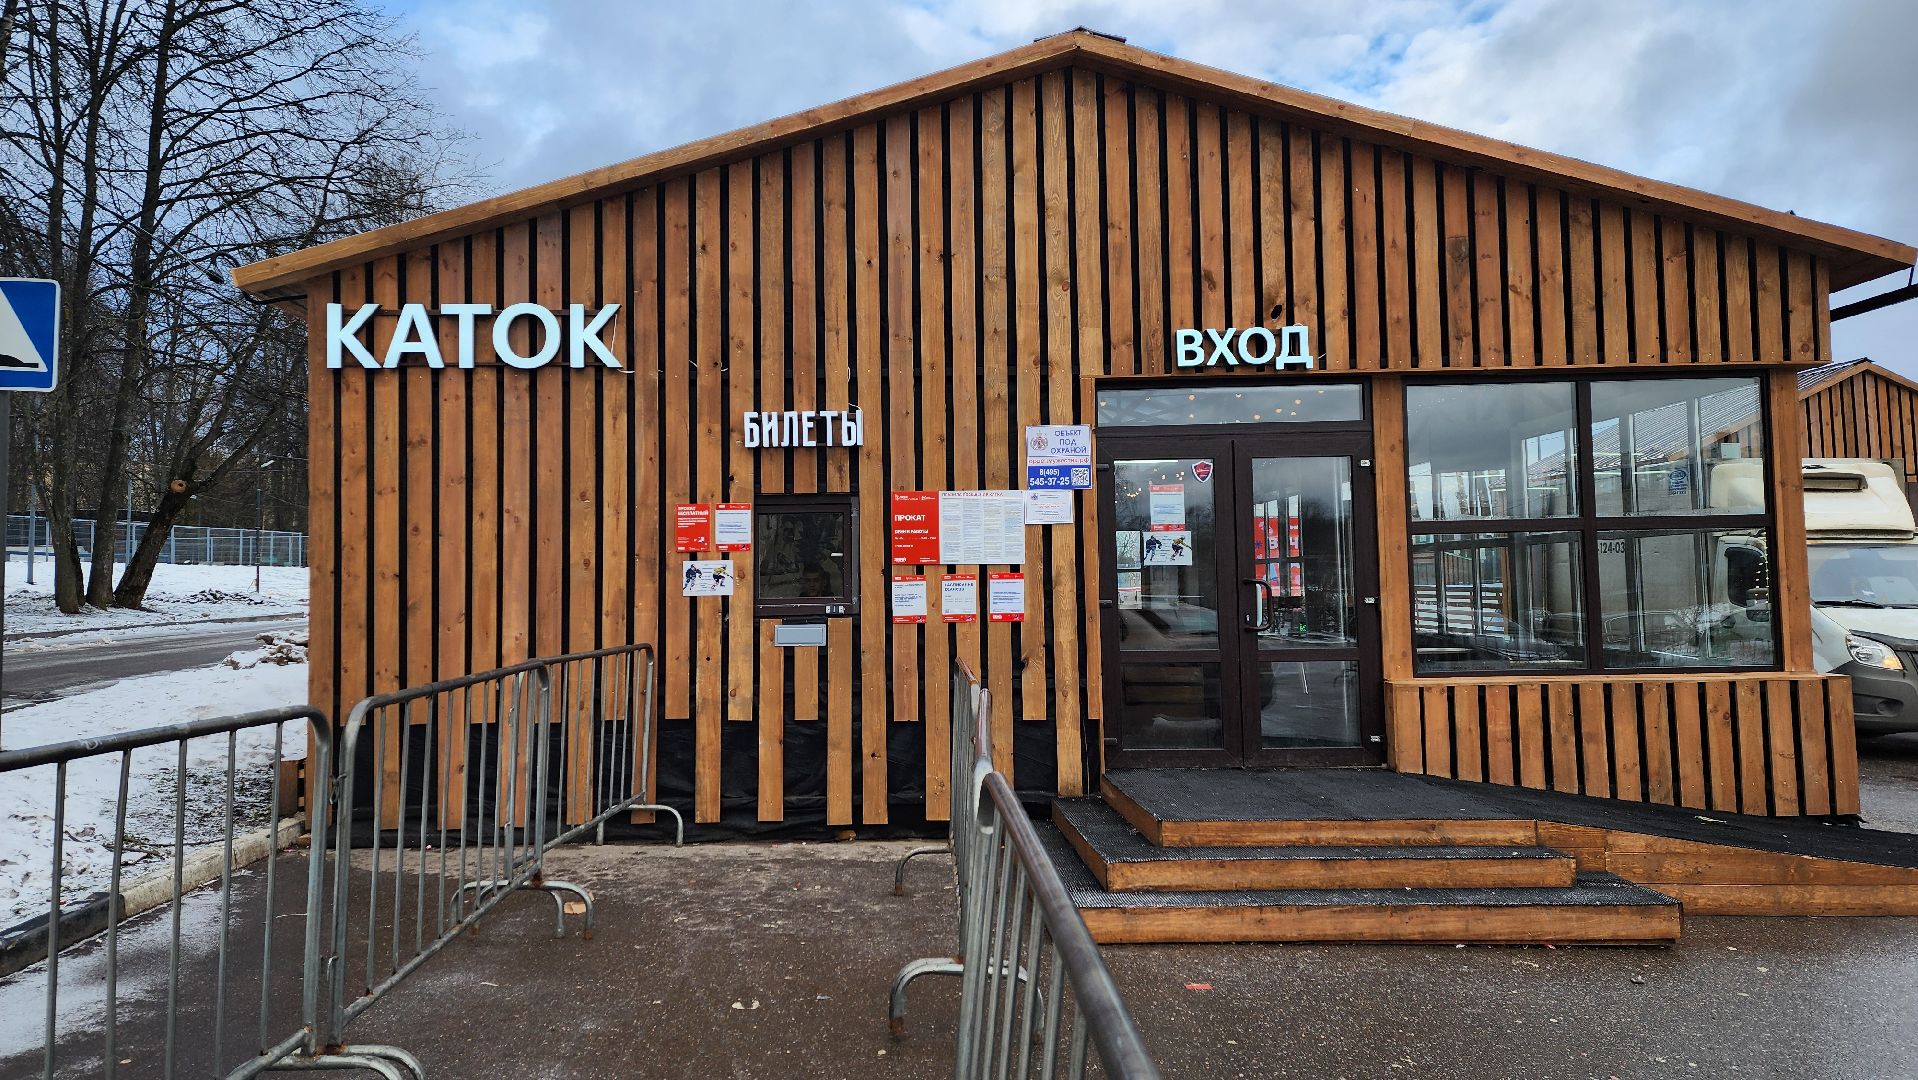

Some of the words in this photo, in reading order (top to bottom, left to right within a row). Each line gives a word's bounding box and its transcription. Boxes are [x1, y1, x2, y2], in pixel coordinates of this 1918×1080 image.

[326, 302, 624, 369] КАТОК
[1175, 326, 1314, 370] ВХОД
[743, 410, 864, 448] БИЛЕТЫ
[1054, 429, 1082, 437] ОБЪЕКТ
[1059, 438, 1077, 446] ПОД
[1050, 445, 1087, 454] ОХРАНОЙ
[1039, 468, 1060, 477] 8(495)
[1029, 476, 1070, 486] 545-37-25
